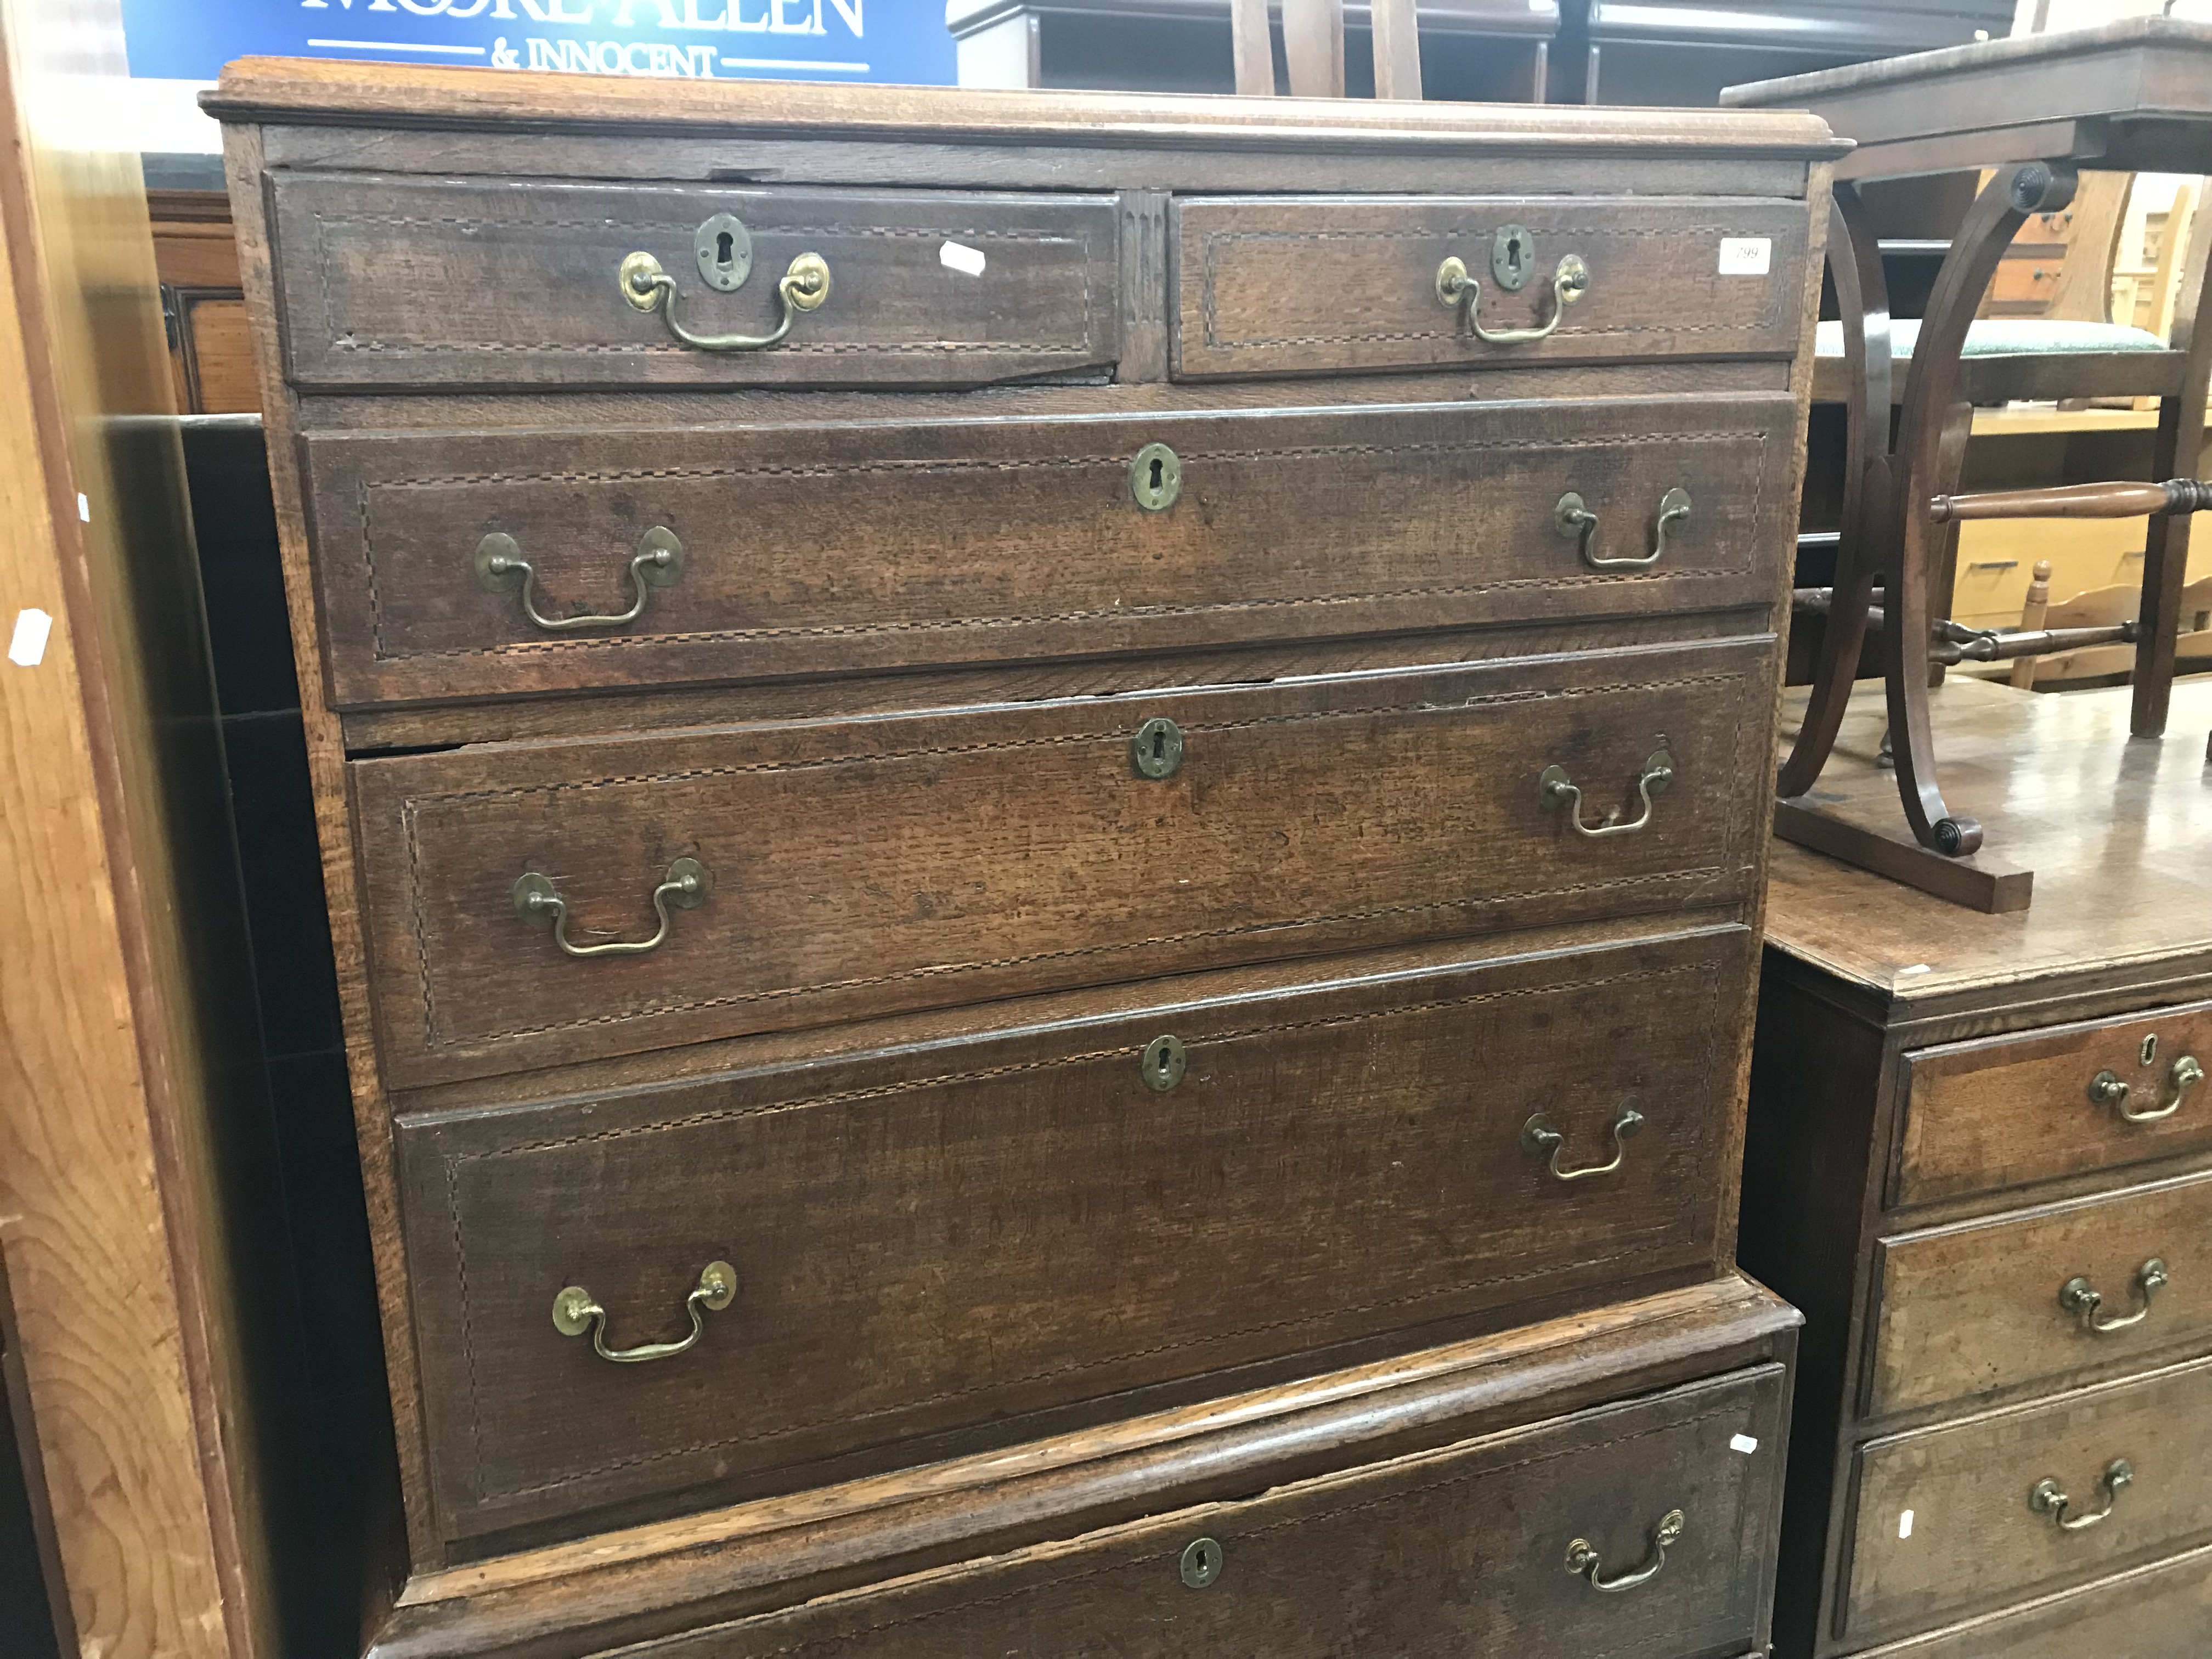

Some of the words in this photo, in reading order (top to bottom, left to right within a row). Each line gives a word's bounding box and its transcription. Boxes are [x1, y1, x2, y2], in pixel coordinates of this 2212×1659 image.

[491, 37, 520, 69] &
[525, 38, 718, 78] INNOCENT
[1736, 247, 1759, 258] 799
